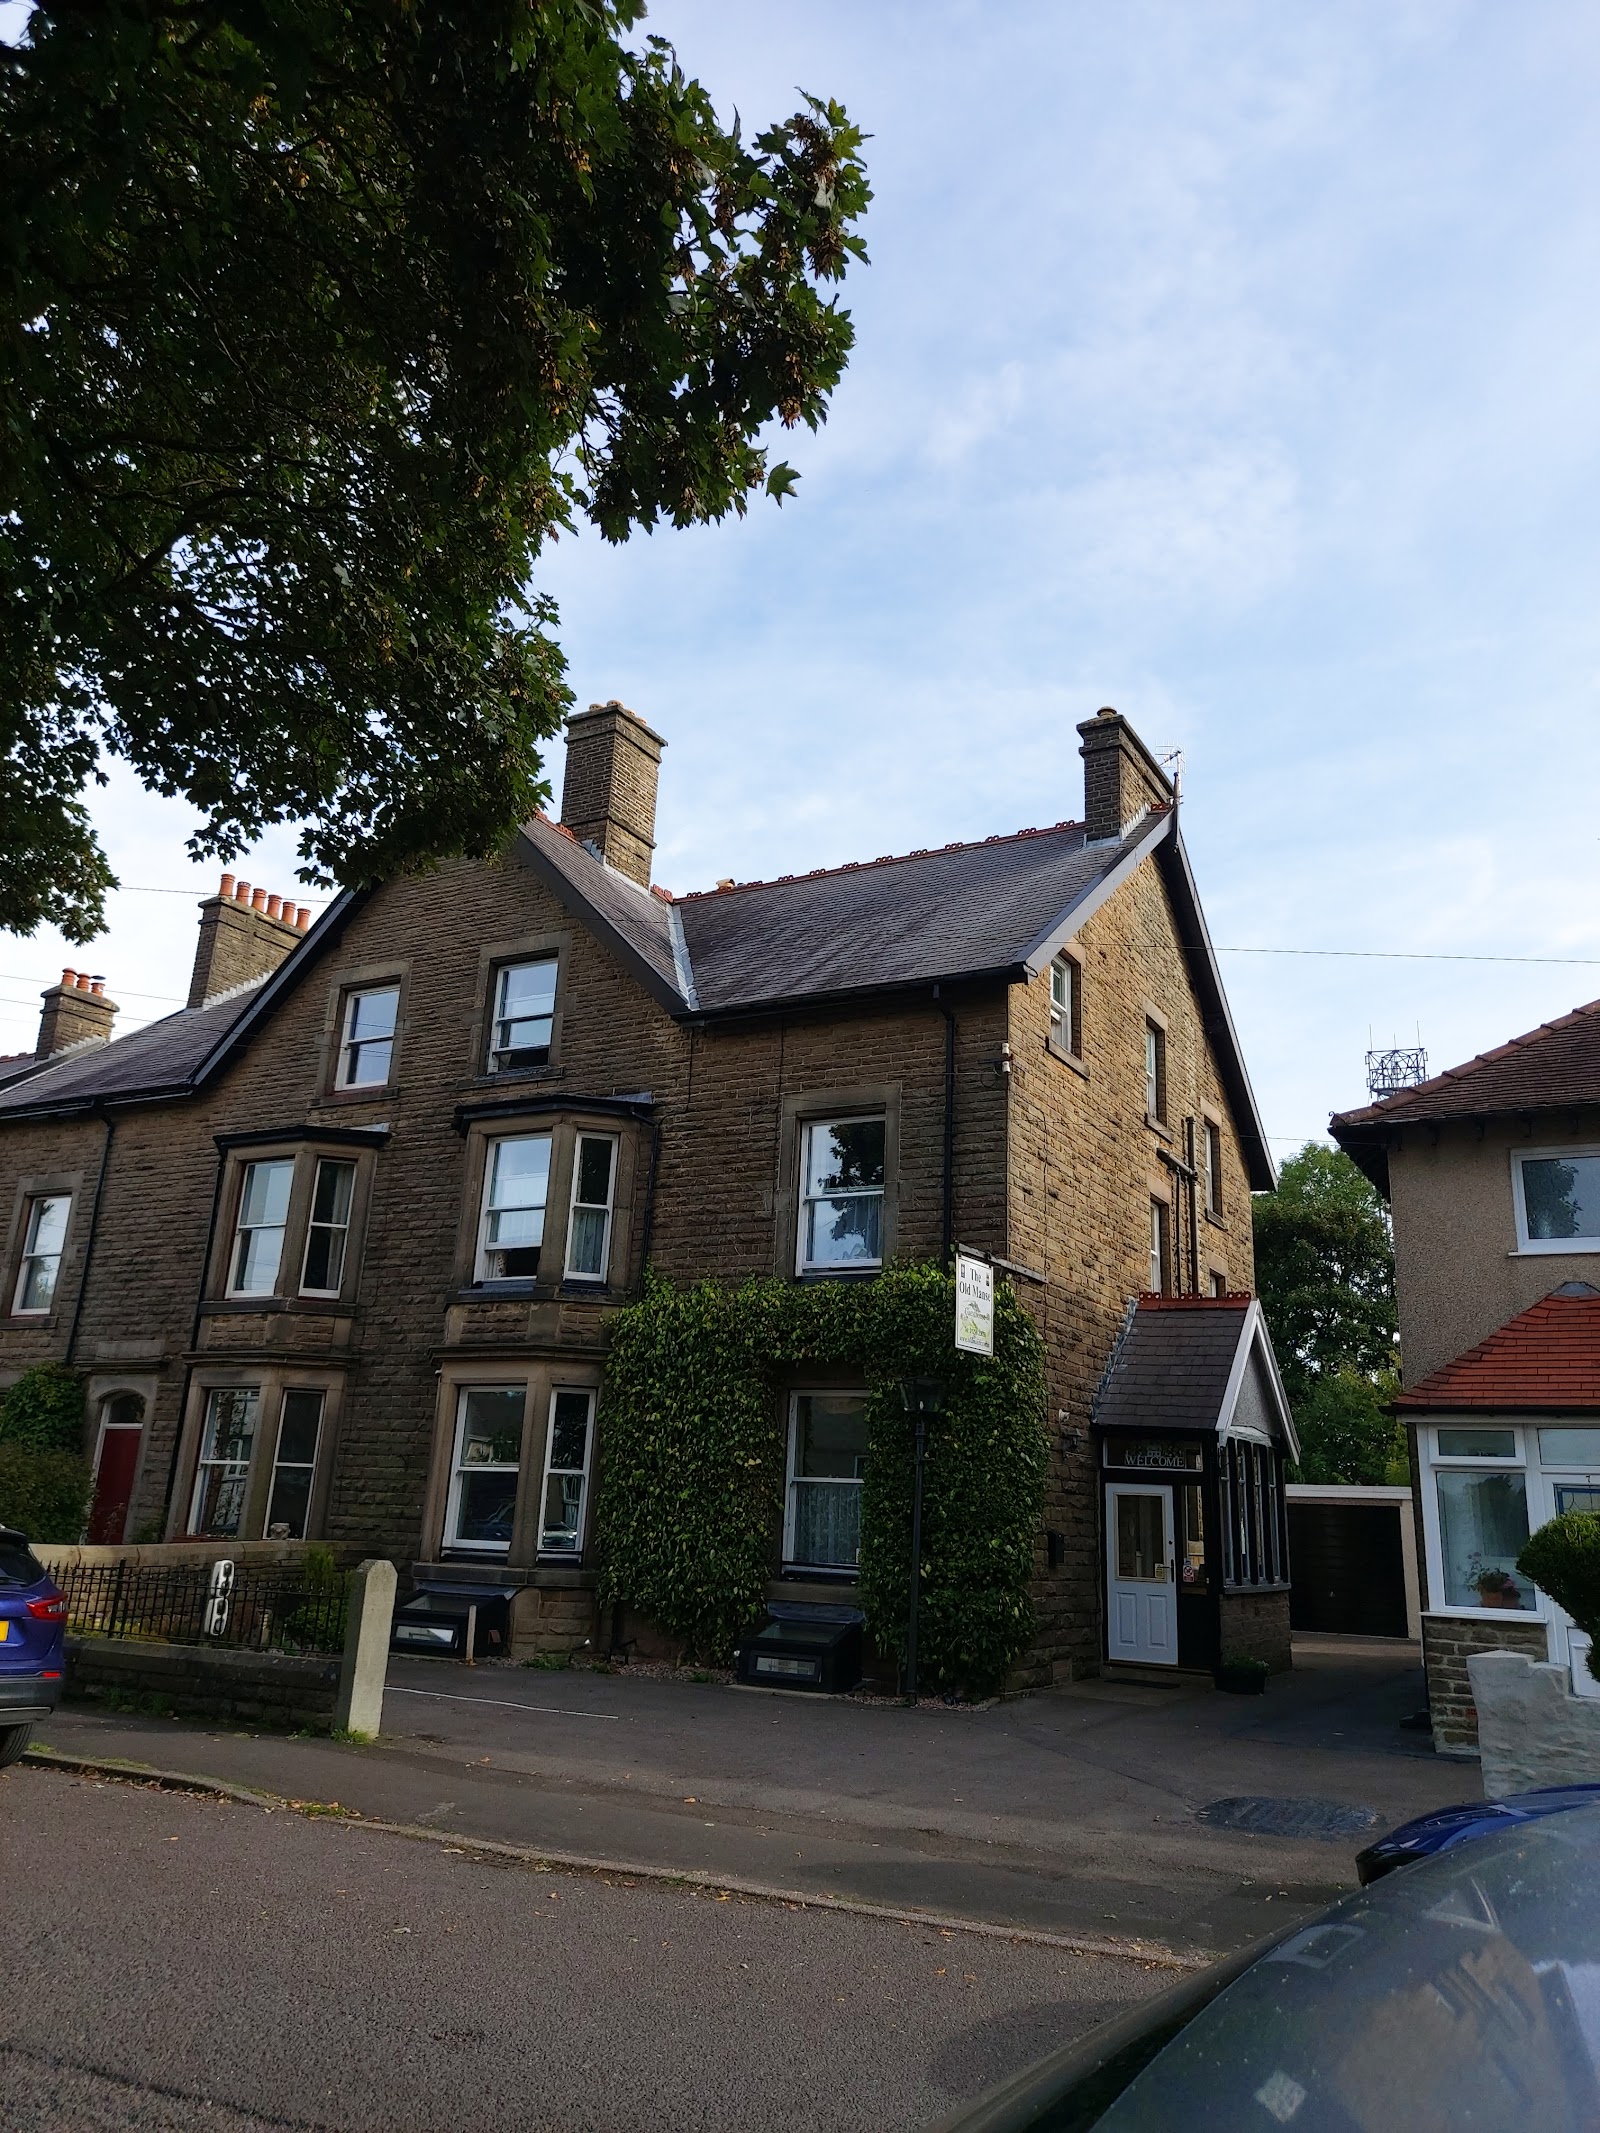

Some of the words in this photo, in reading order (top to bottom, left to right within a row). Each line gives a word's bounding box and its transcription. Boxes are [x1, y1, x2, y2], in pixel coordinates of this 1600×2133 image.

[970, 1267, 981, 1282] The
[960, 1281, 971, 1296] Old
[972, 1284, 991, 1302] Manse
[1125, 1455, 1185, 1467] WELCOME
